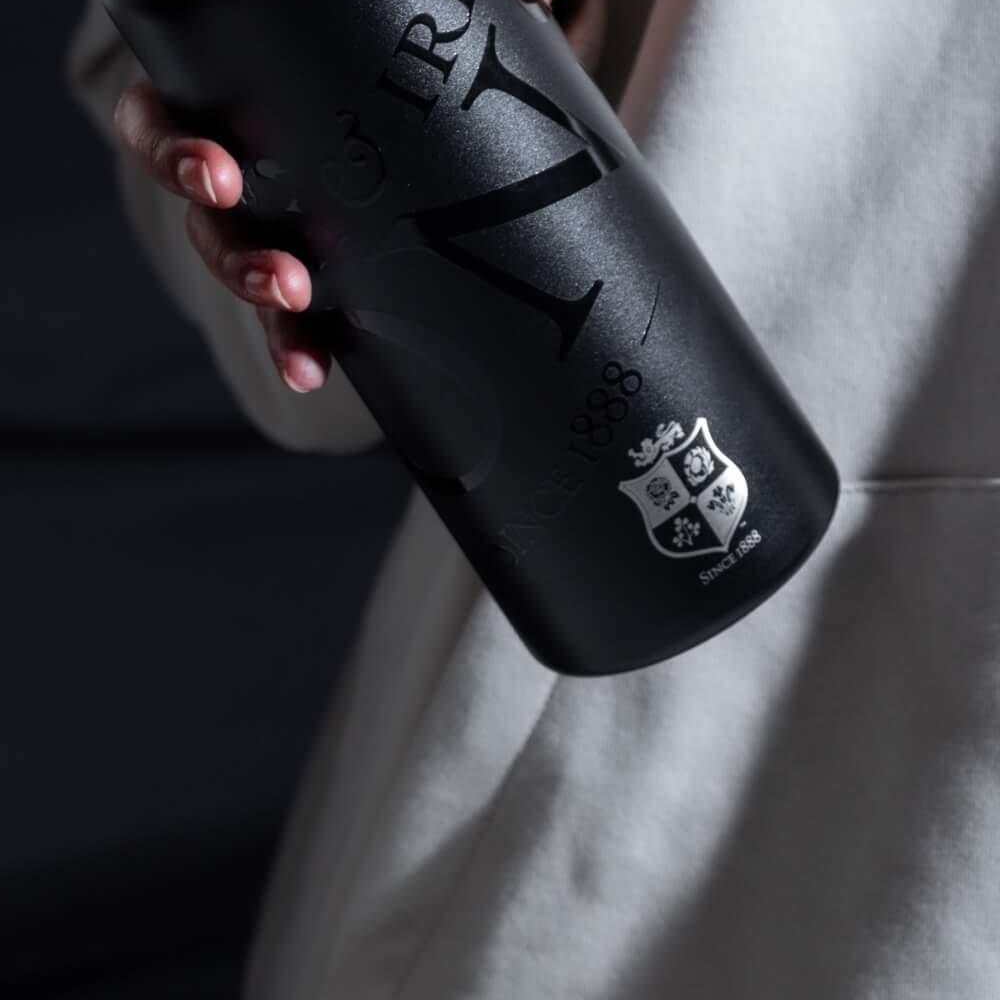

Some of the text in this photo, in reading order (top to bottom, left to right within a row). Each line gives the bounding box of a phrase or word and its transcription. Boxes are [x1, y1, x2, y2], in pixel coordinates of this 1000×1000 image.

[567, 361, 642, 462] 1888
[698, 529, 762, 585] SINCE 1888
